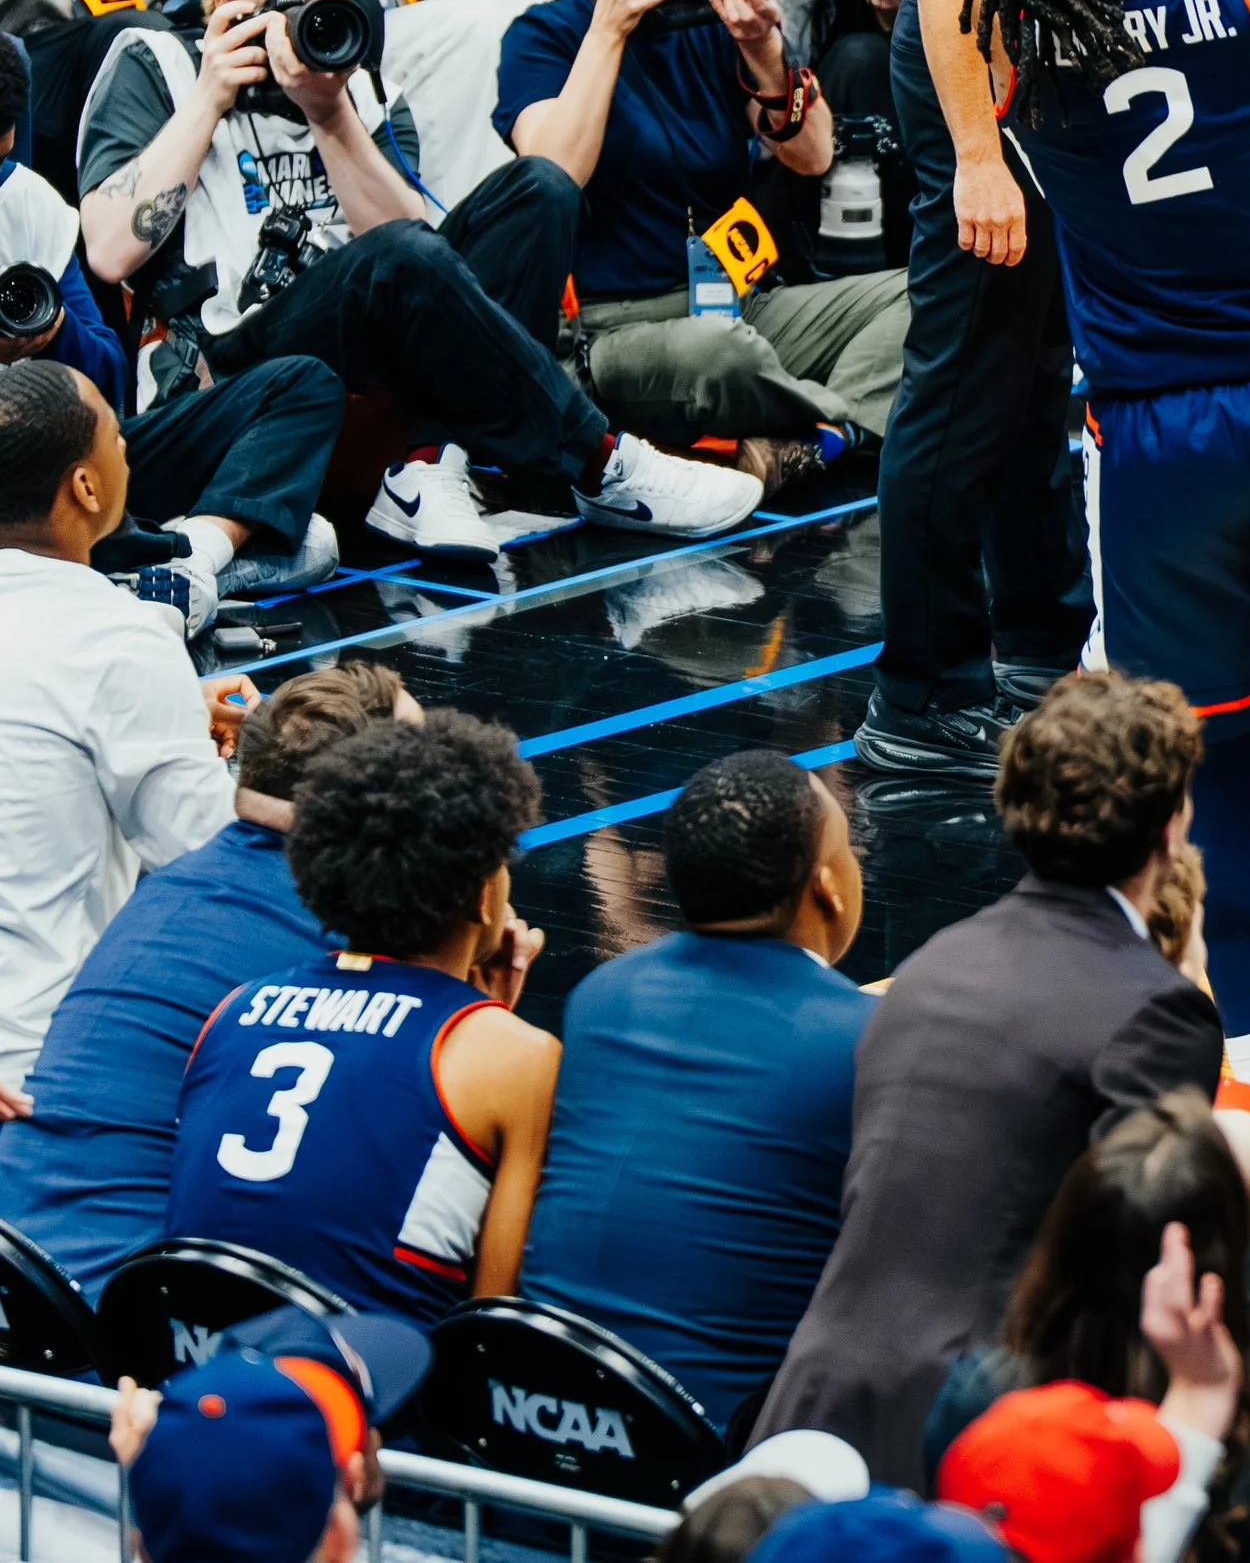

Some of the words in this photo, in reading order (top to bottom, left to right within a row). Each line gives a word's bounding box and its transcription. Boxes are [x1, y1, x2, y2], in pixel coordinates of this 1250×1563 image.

[1103, 66, 1215, 206] 2
[238, 984, 423, 1038] STEWART
[216, 1040, 335, 1182] 3
[488, 1377, 635, 1460] NCAA
